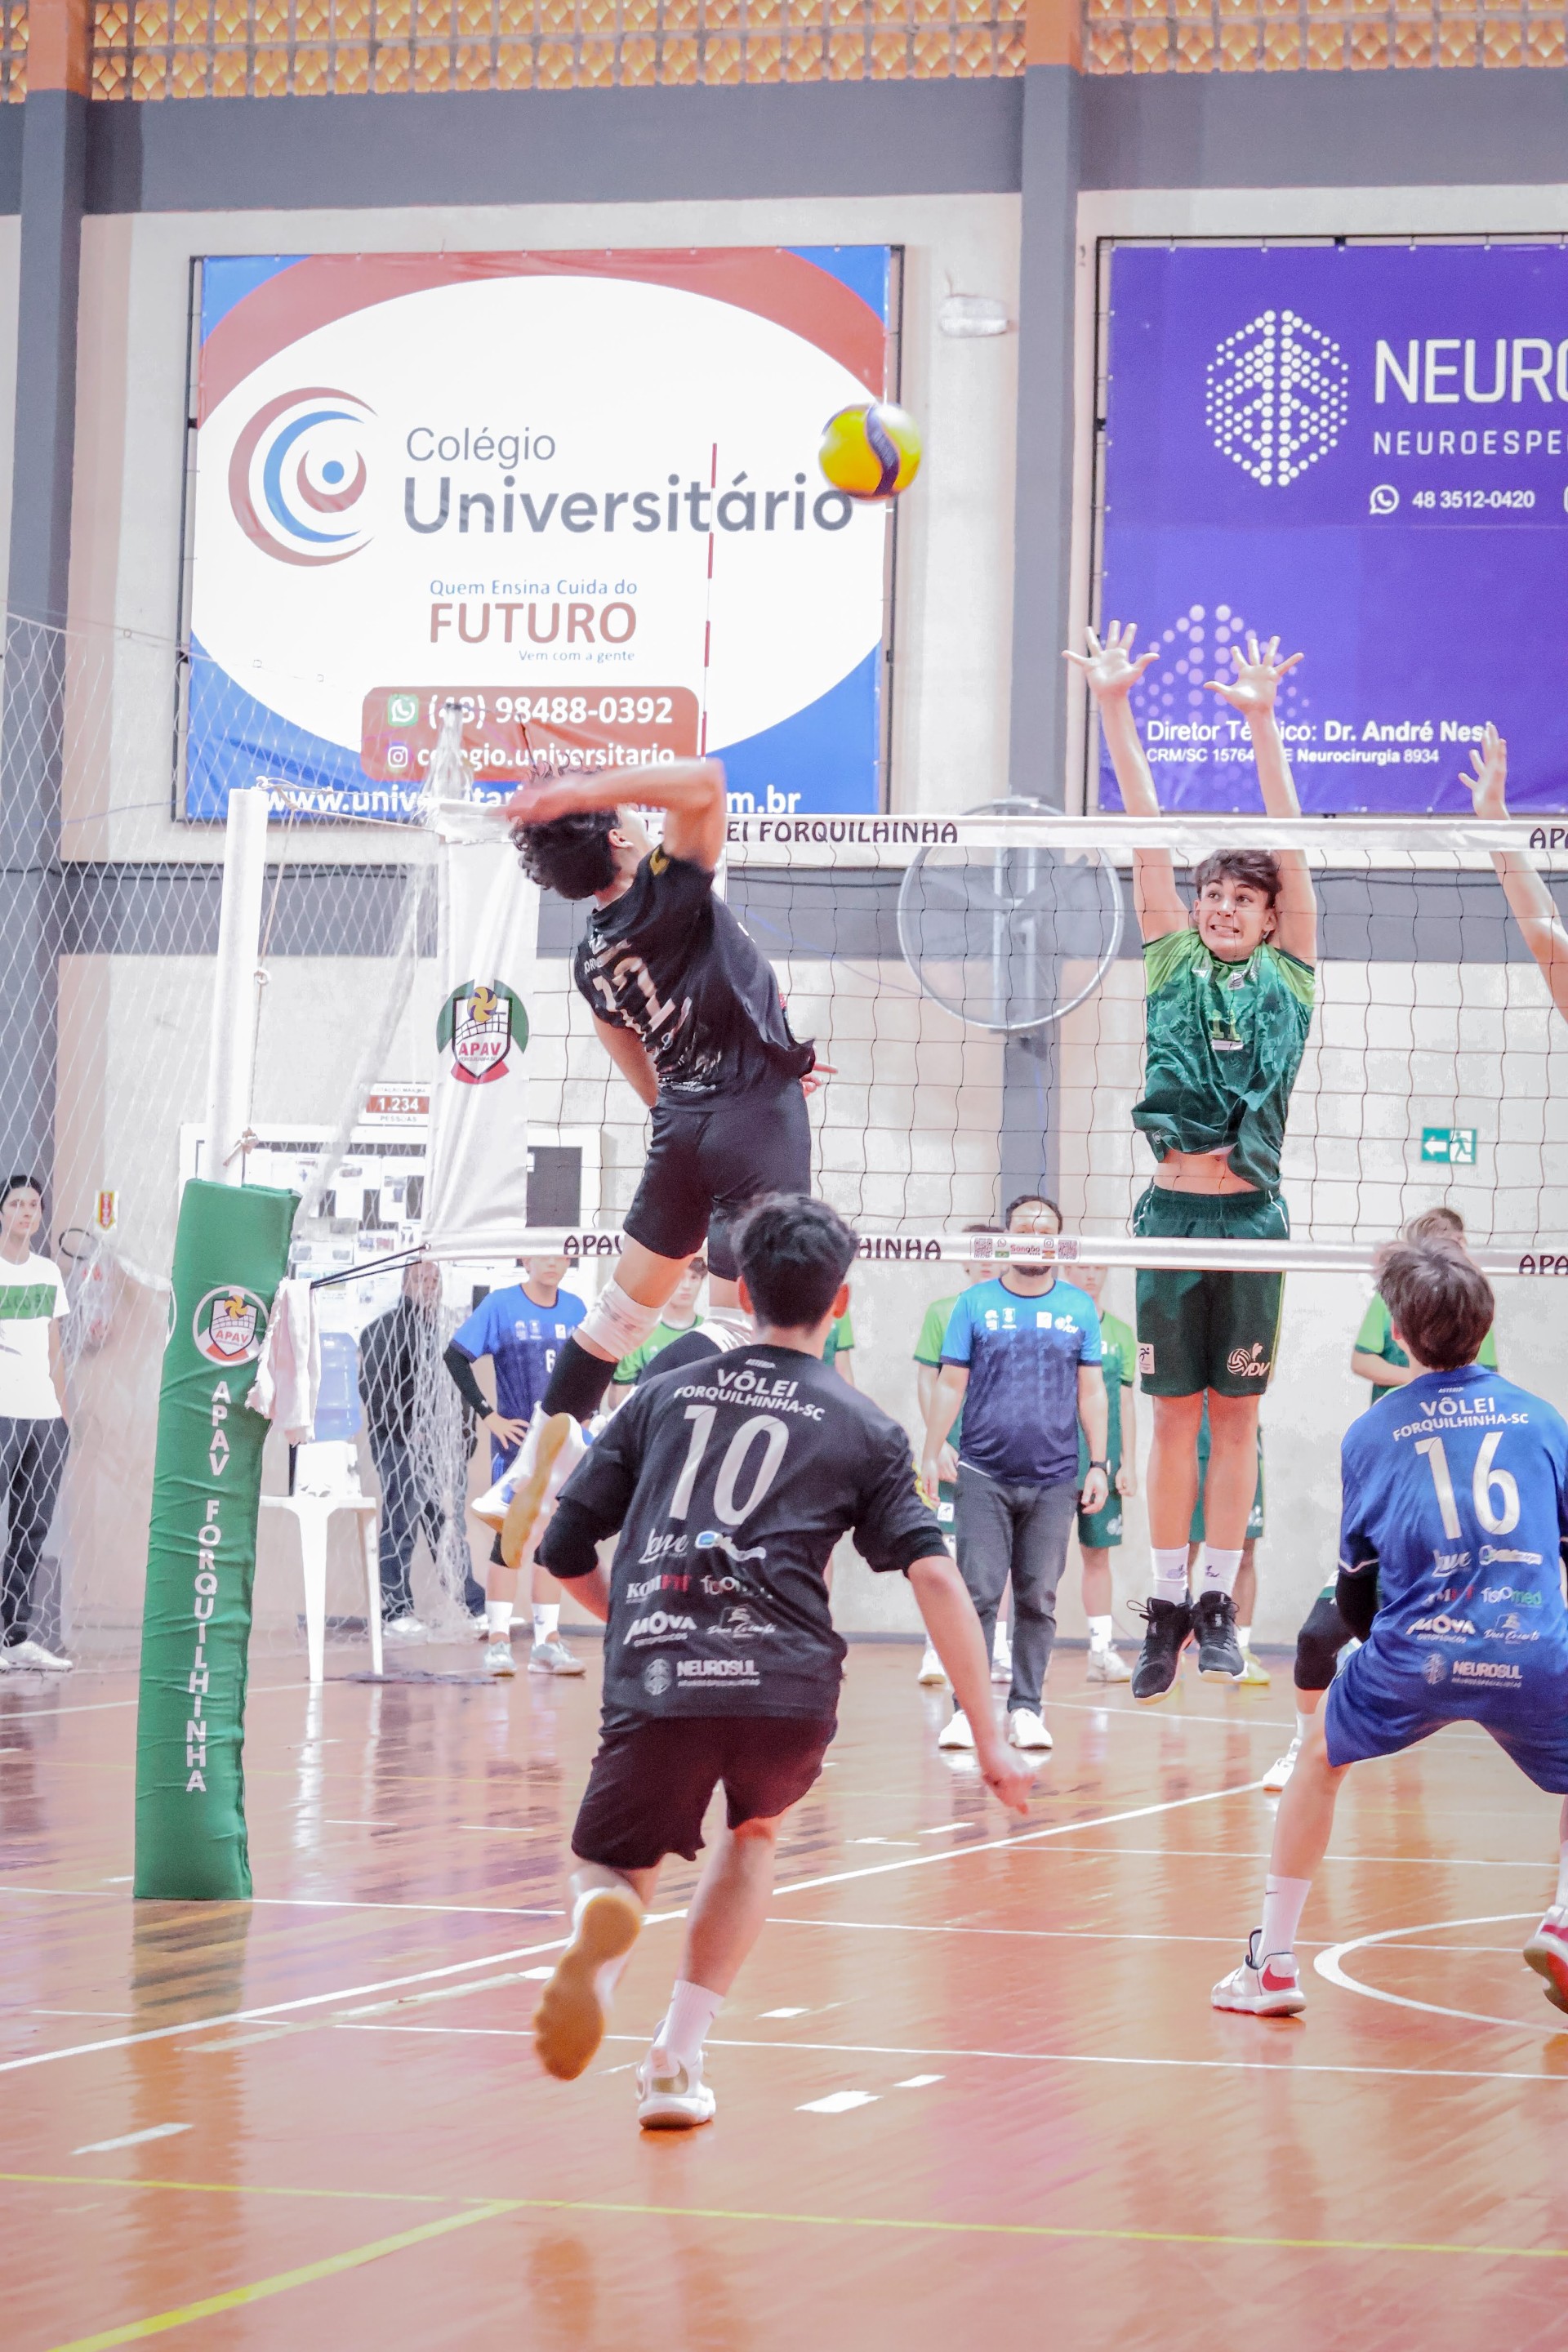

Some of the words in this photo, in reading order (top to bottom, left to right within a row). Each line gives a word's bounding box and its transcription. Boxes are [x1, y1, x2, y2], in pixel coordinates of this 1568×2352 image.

[1374, 337, 1568, 403] NEUR
[406, 426, 556, 470] Colégio
[1373, 429, 1568, 455] NEUROESPE
[403, 470, 853, 534] Universitário
[1413, 491, 1435, 508] 48
[1440, 489, 1535, 508] 3512-0420
[430, 579, 485, 596] Quem
[492, 578, 550, 595] Ensina
[557, 578, 608, 595] Cuida
[614, 578, 638, 595] do
[430, 601, 637, 644] FUTURO
[519, 650, 548, 661] Vem
[553, 652, 581, 661] com
[586, 653, 593, 661] a
[597, 651, 635, 663] gente
[495, 696, 673, 724] 98488-0392
[1147, 720, 1220, 742] Diretor
[1225, 719, 1317, 742] Téico:
[1324, 720, 1356, 742] Dr.
[1361, 720, 1434, 742] André
[1146, 748, 1208, 763] CRM/SC
[1212, 748, 1255, 763] 15764
[1297, 748, 1401, 766] Neurocirurgia
[1403, 748, 1440, 763] 8934
[759, 821, 959, 844] FORQUILHINHA
[1529, 827, 1568, 849] AP
[458, 1042, 502, 1057] APAV
[379, 1097, 420, 1111] 1.234
[215, 1329, 248, 1343] APAV
[716, 1369, 800, 1398] VÔLEI
[673, 1384, 826, 1422] FORQUILHINHA-SC
[1419, 1396, 1495, 1417] VÔLEI
[209, 1381, 232, 1477] APAV
[1392, 1413, 1530, 1442] FORQUILHINHA-SC
[668, 1404, 790, 1526] 10
[1414, 1431, 1521, 1540] 16
[623, 1610, 697, 1645] MOVA
[1405, 1614, 1477, 1636] MOVA
[185, 1499, 223, 1793] FORQUILHINHA
[676, 1659, 760, 1677] NEUROSUL
[1452, 1660, 1523, 1680] NEUROSUL
